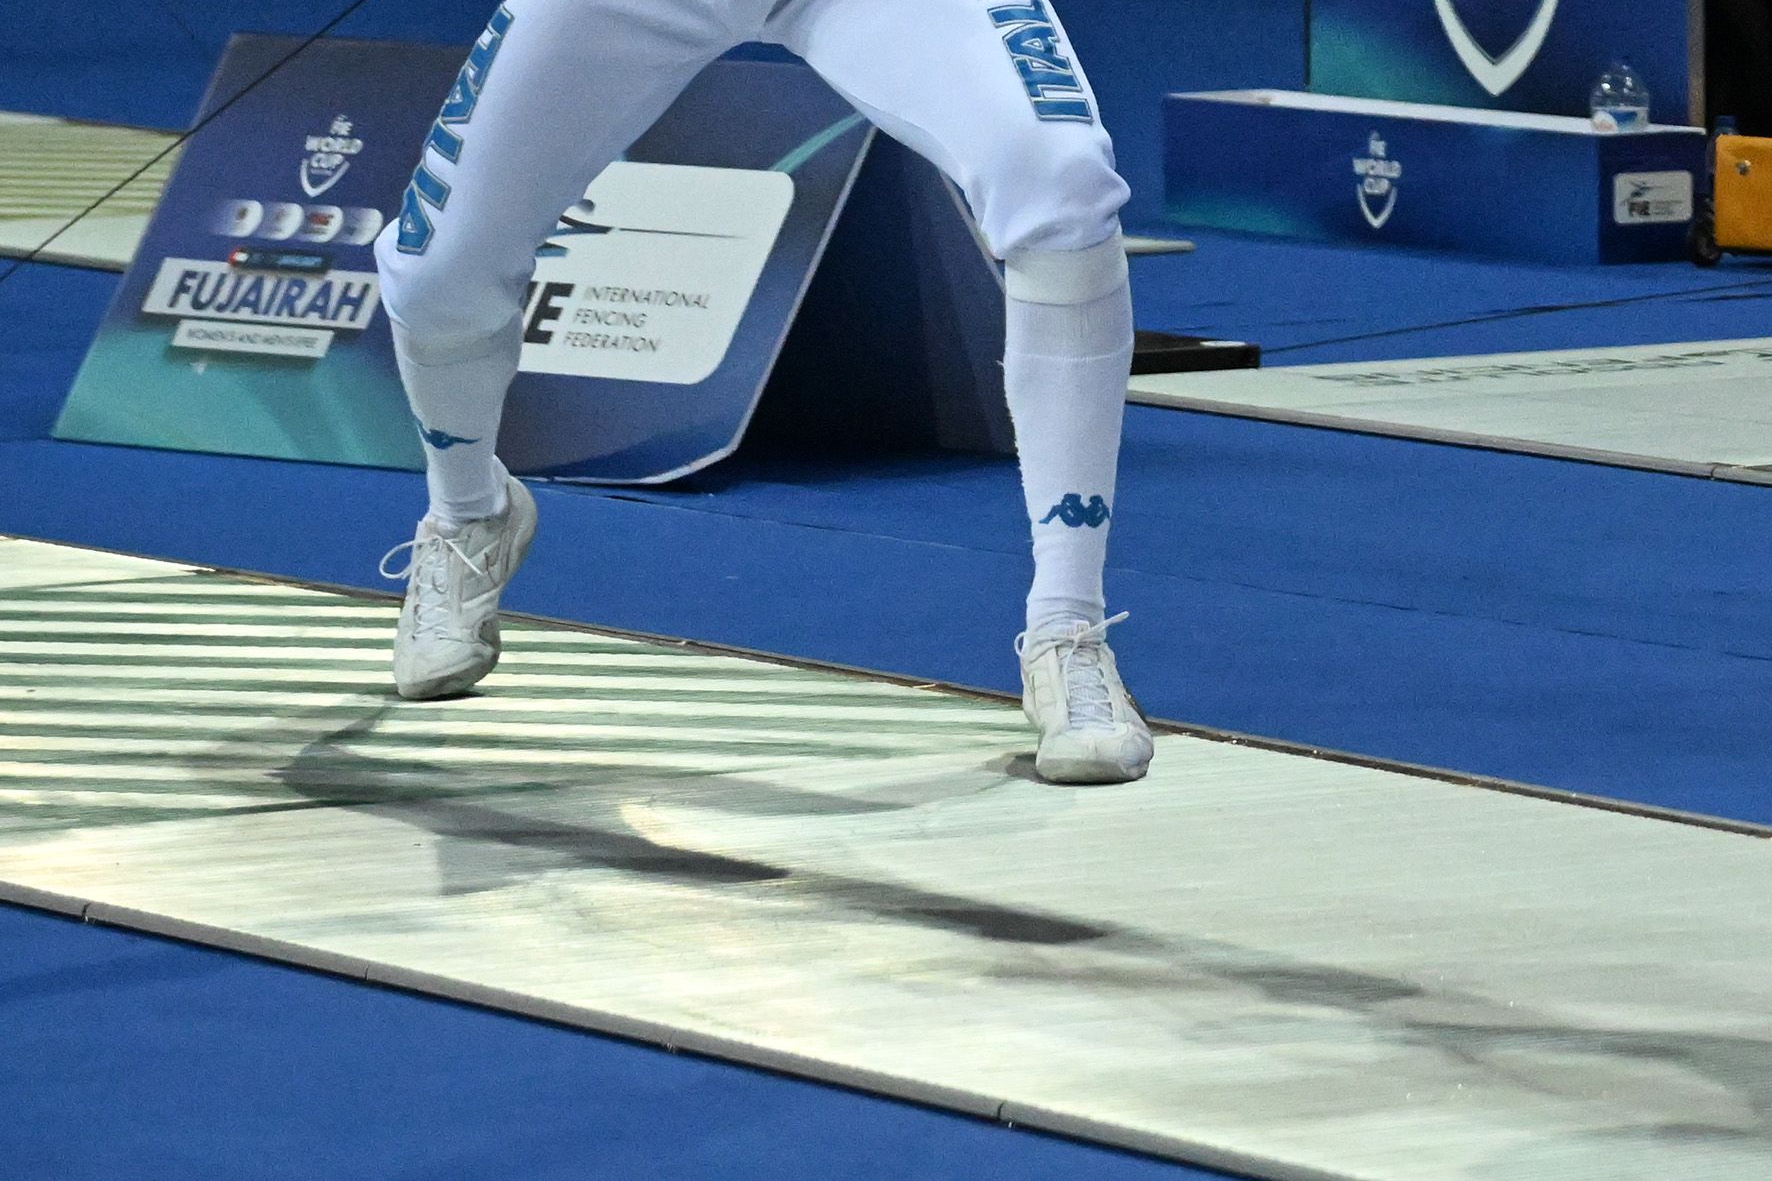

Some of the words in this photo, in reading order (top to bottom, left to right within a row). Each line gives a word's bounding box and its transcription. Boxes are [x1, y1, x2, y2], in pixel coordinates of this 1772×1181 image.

[167, 270, 371, 322] FUJAIRAH
[583, 286, 710, 310] INTERNATIONAL
[574, 307, 648, 329] FENCING
[563, 330, 662, 353] FEDERATION
